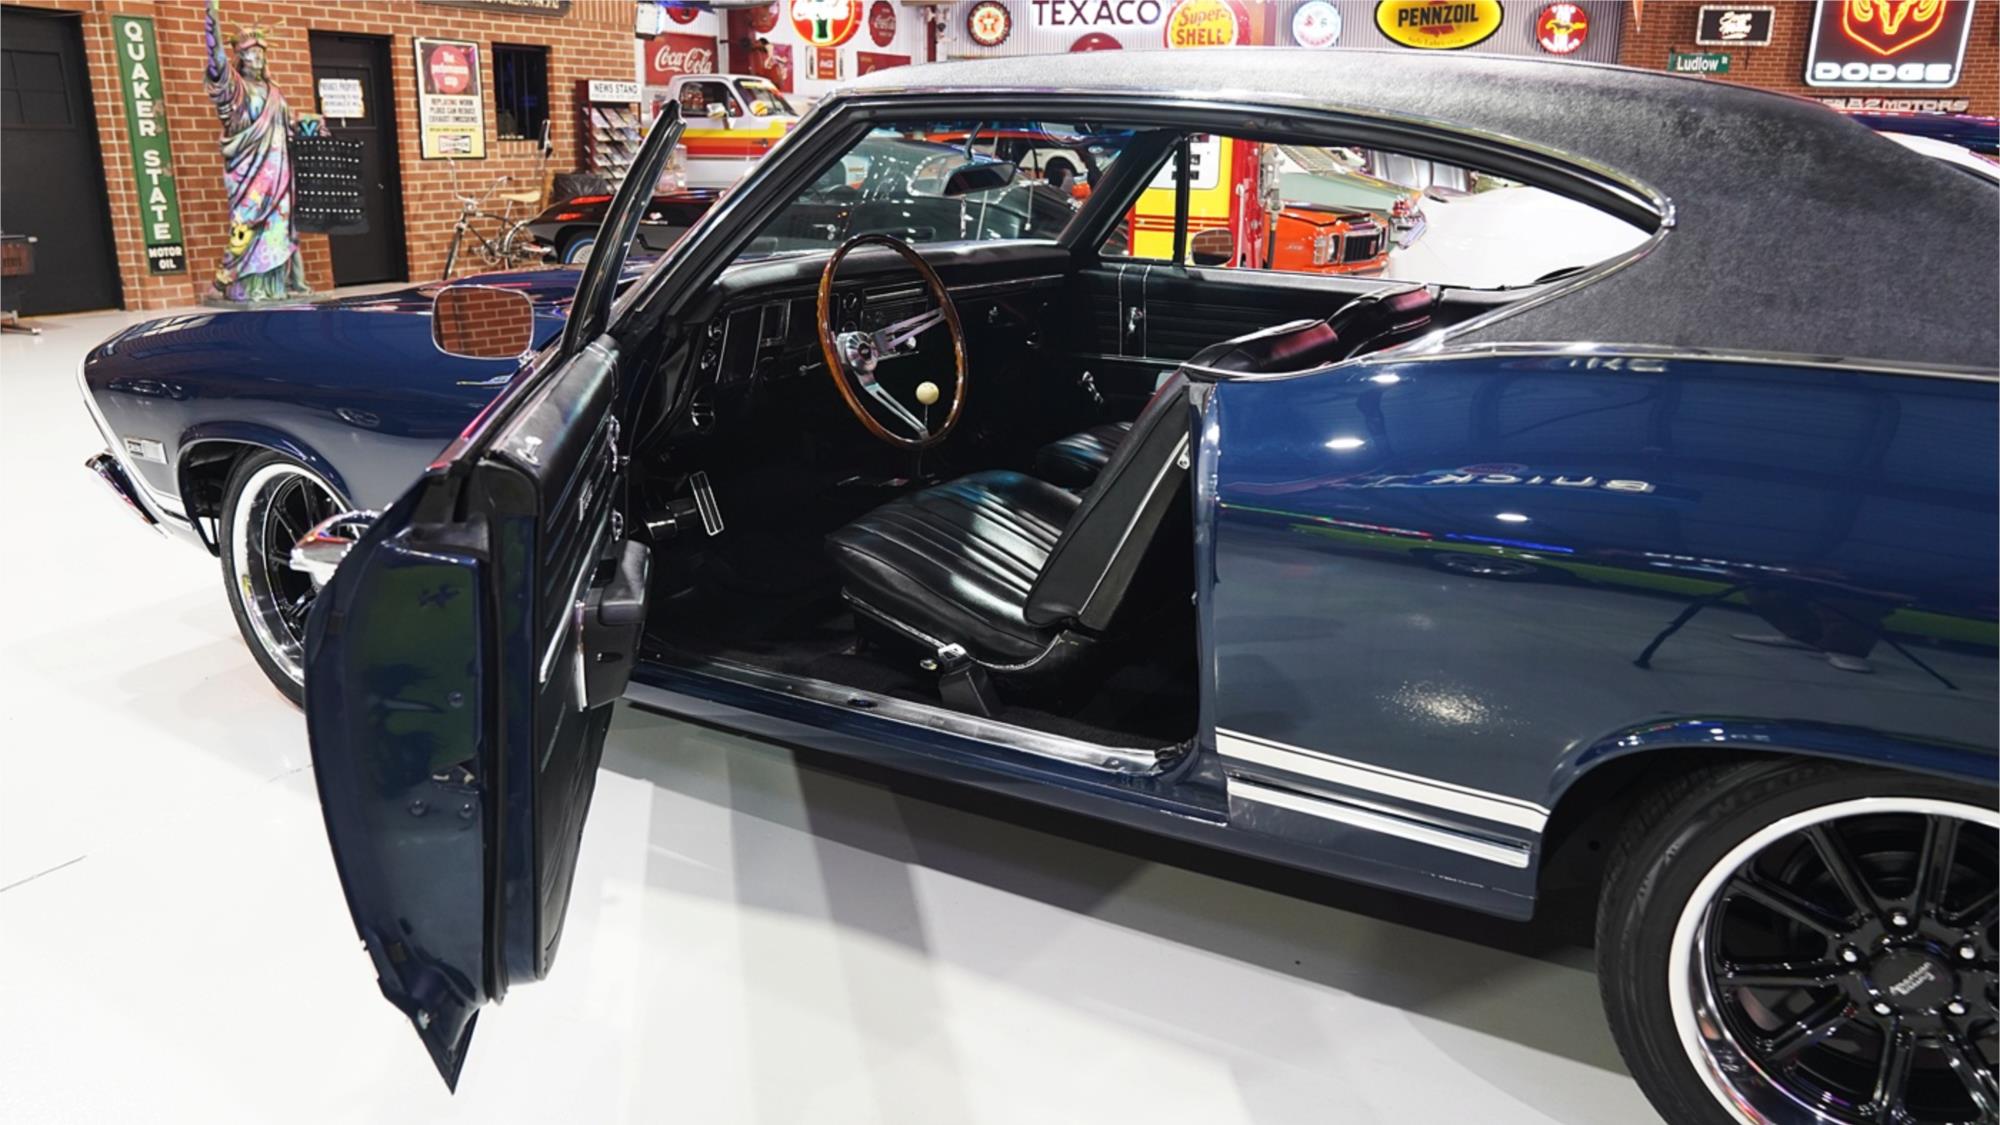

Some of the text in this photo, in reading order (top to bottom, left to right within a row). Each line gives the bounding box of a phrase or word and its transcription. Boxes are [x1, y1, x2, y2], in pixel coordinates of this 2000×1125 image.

[1032, 0, 1162, 26] TEXACO
[1397, 3, 1479, 28] PENNZOIL
[1176, 28, 1225, 46] SHELL
[654, 44, 713, 75] Coca-Cola
[1676, 55, 1719, 72] Ludlow
[1814, 61, 1952, 82] DODGE
[593, 83, 638, 95] NEWS STAND
[123, 20, 172, 241] QUAKER STATE
[148, 246, 183, 259] MOTOR
[158, 258, 177, 270] OIL
